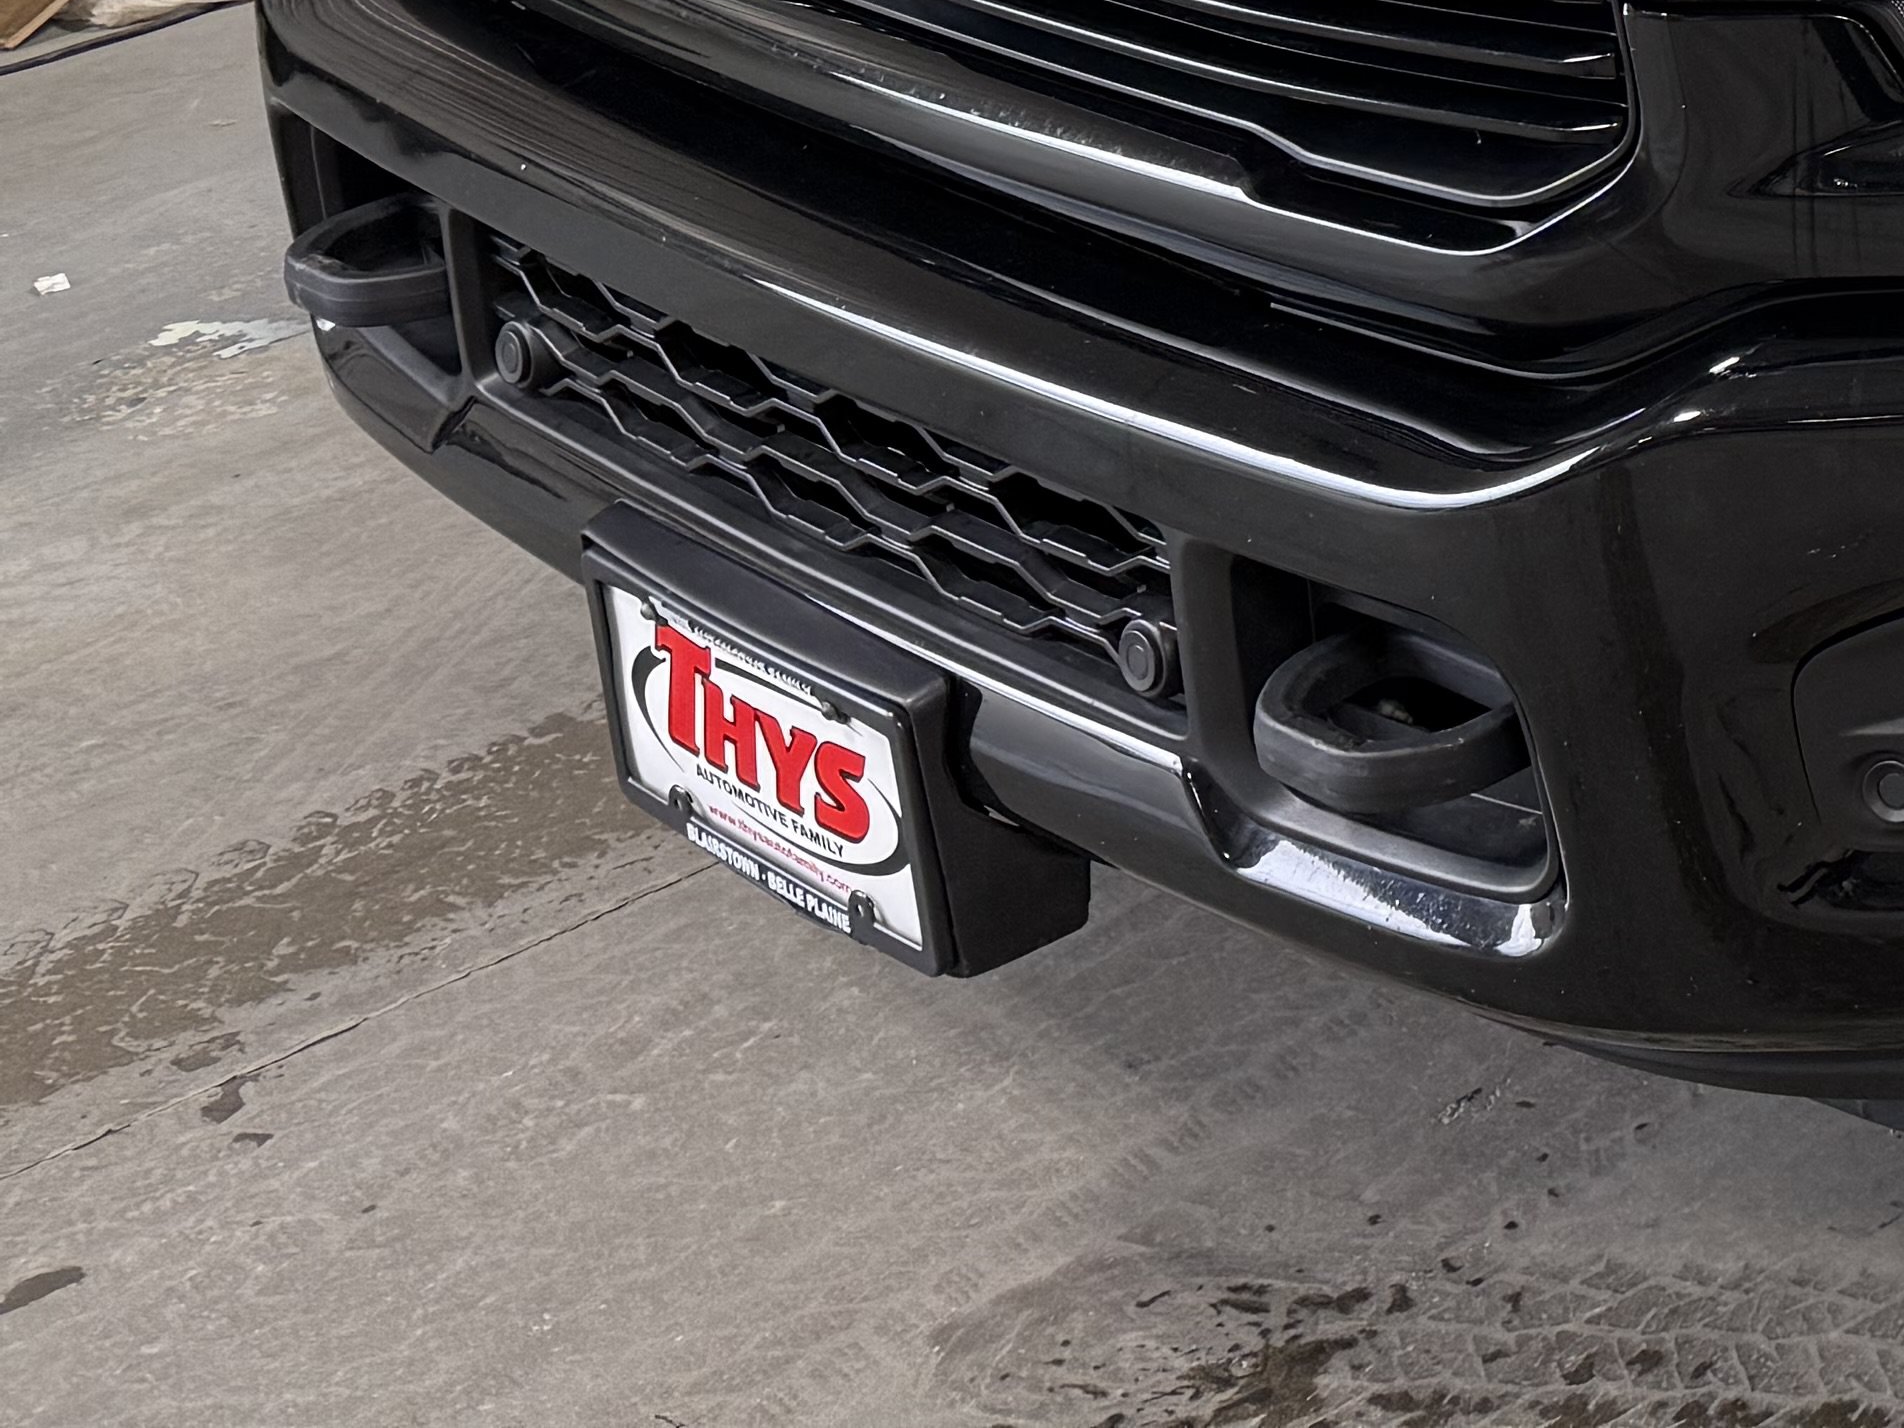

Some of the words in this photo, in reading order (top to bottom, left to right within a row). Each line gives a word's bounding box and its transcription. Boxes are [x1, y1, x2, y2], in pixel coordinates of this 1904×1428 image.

[656, 624, 870, 842] THYS
[696, 764, 789, 828] AUTOMOTIVE
[791, 815, 845, 858] FAMILY
[686, 822, 761, 881] BLAIRSTOWN
[767, 872, 806, 907] BELLE
[806, 892, 852, 934] PLAINE
